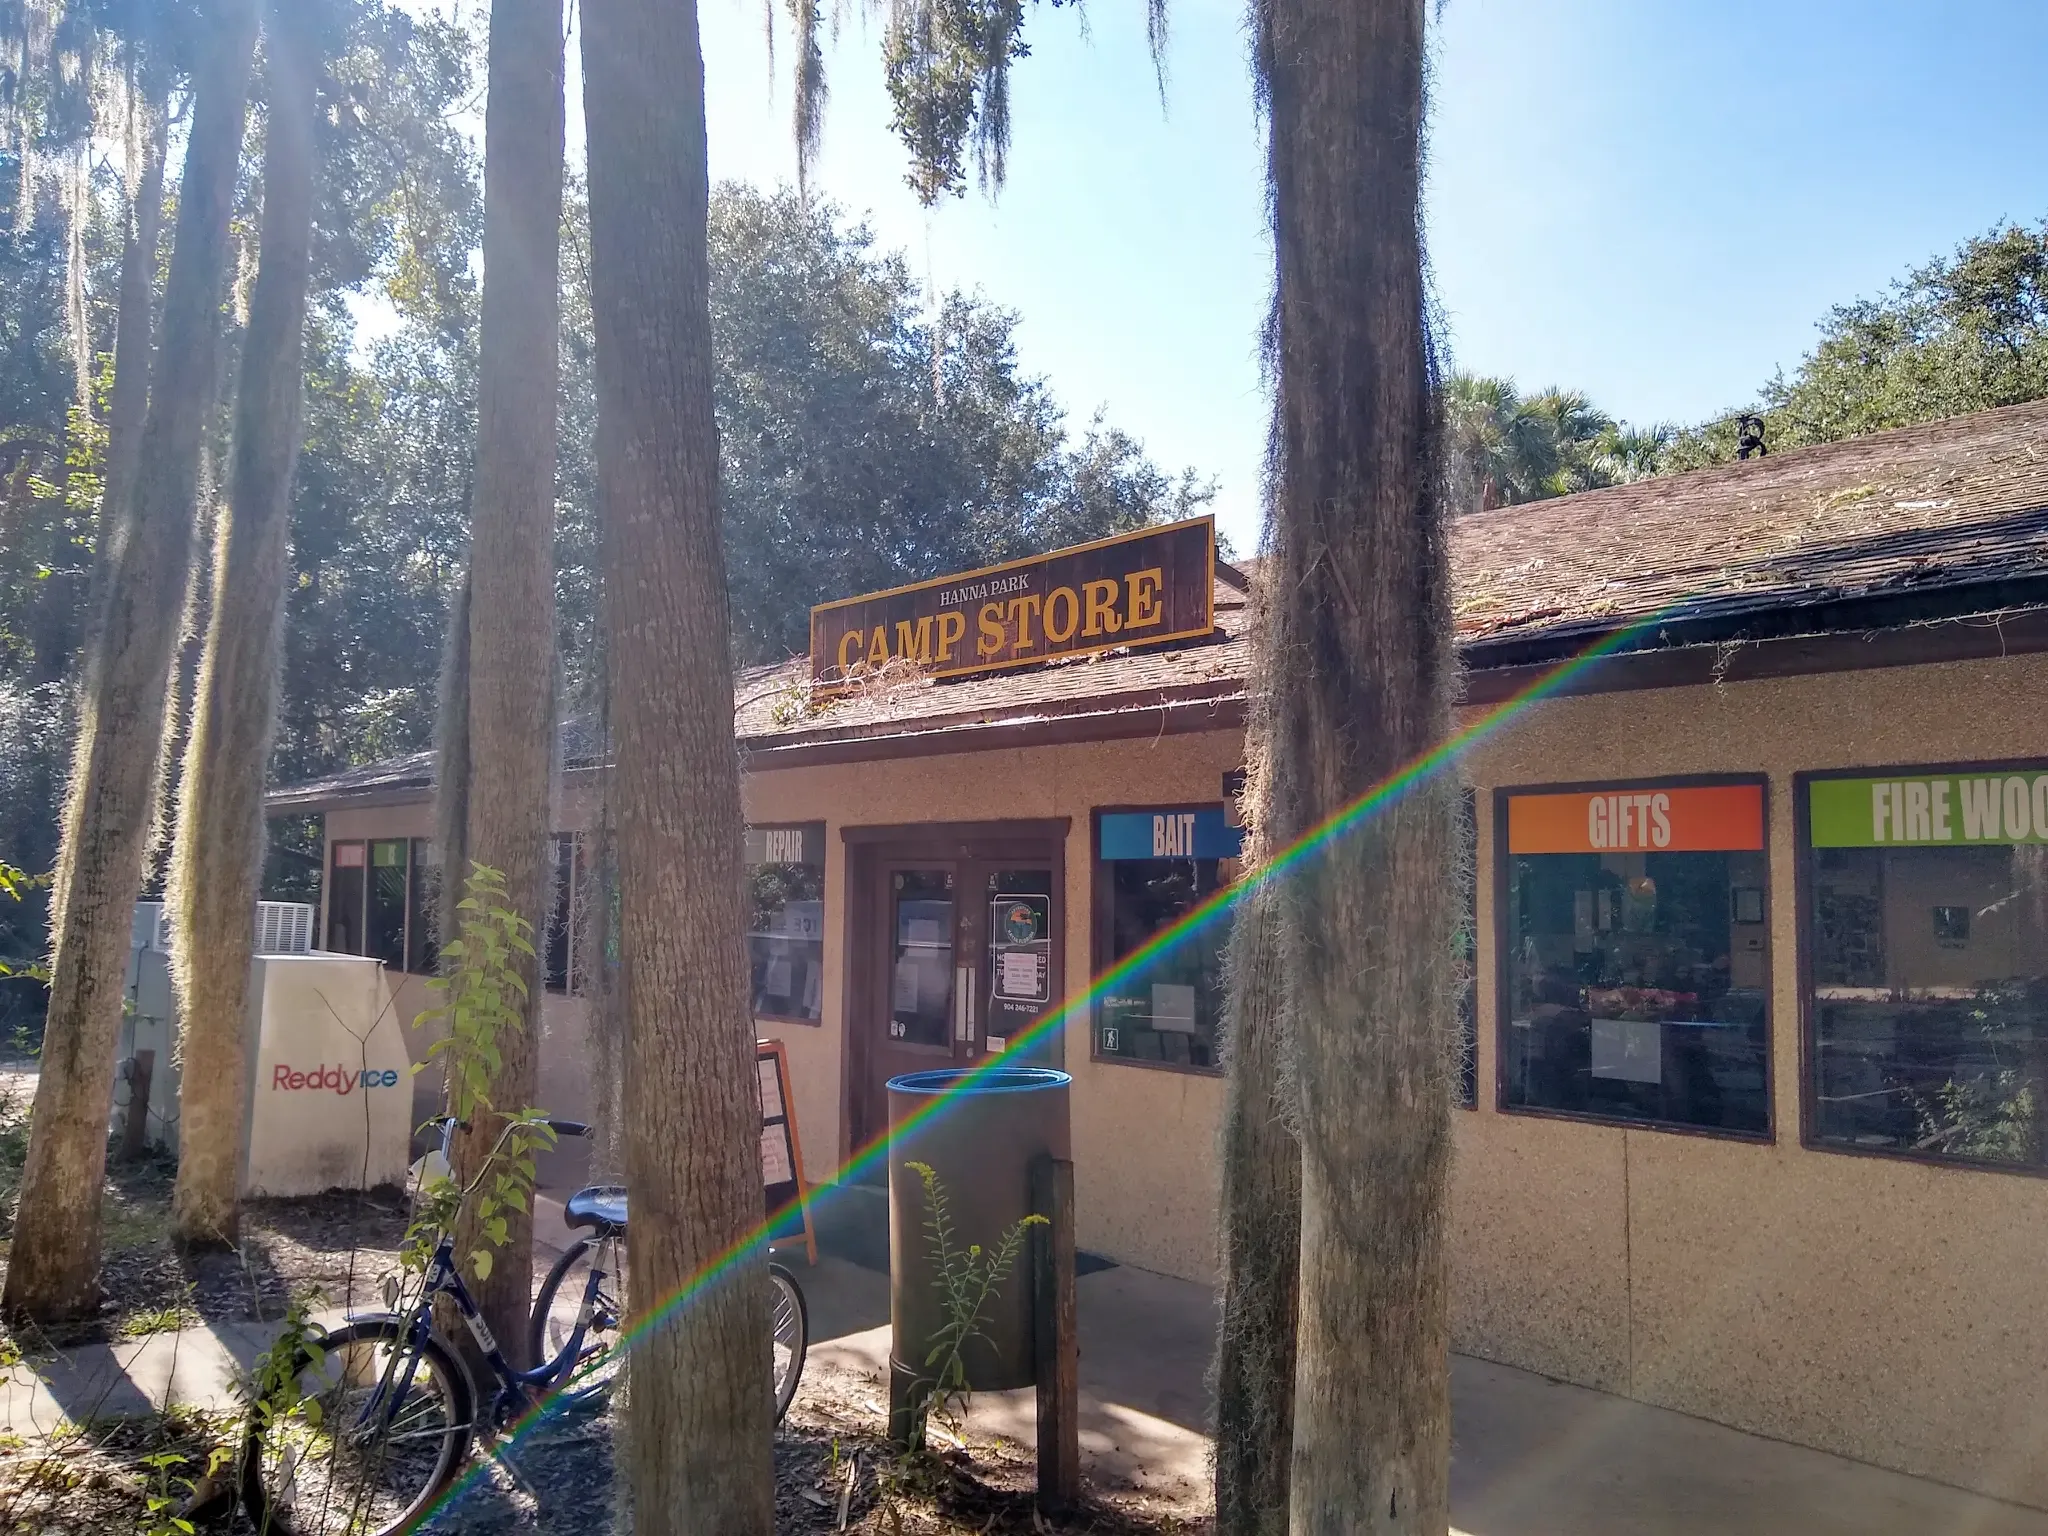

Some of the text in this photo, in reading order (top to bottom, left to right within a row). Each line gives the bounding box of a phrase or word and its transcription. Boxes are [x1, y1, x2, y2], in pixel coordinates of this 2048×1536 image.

[940, 573, 1030, 607] HANNA PARK
[838, 567, 1162, 679] CAMP STORE
[1152, 813, 1196, 857] BAIT
[1587, 792, 1671, 850] GIFTS
[1872, 780, 1953, 842] FIRE
[765, 830, 804, 862] REPAIR
